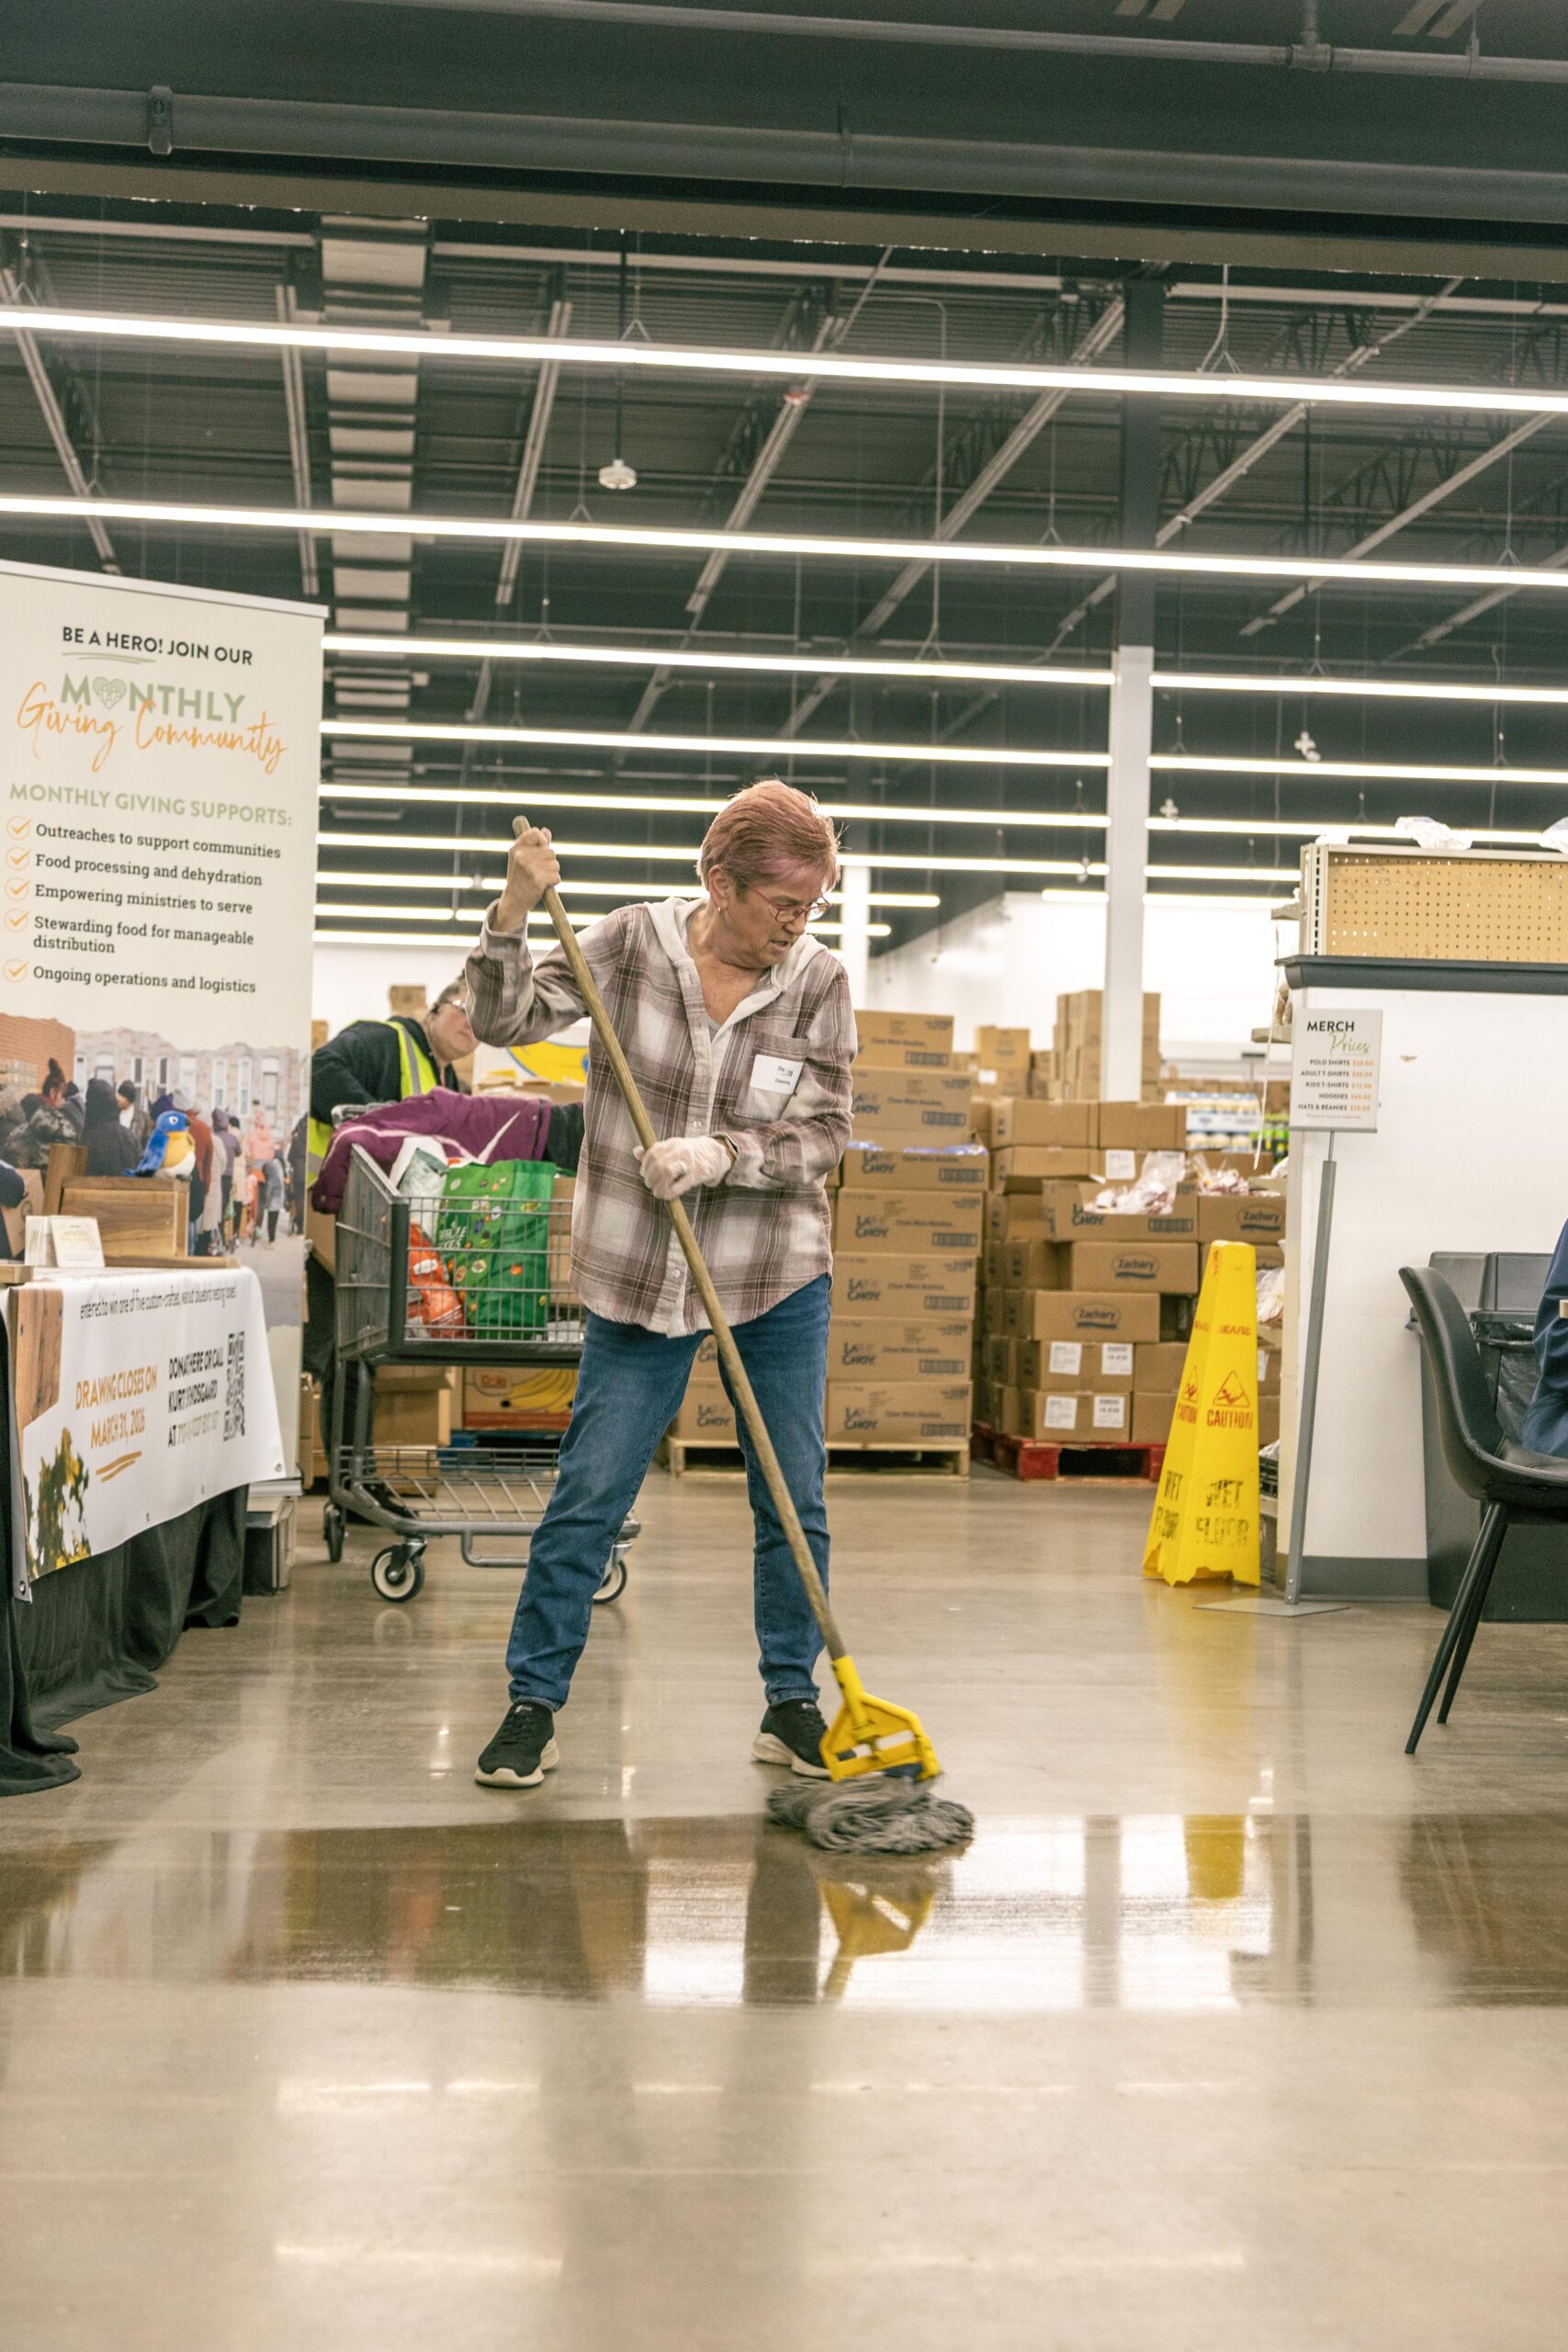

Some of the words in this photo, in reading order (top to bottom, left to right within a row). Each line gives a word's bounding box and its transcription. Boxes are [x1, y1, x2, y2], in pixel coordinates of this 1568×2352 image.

[62, 627, 85, 643] BE
[89, 631, 101, 645] A
[107, 632, 164, 653] HERO!
[167, 639, 209, 659] JOIN
[215, 648, 253, 665] OUR
[17, 682, 125, 773] Giving
[135, 698, 288, 775] Community
[9, 783, 110, 808] MONTHLY
[115, 793, 185, 815] GIVING
[190, 801, 292, 827] SUPPORTS:
[36, 824, 115, 844] Outreaches
[119, 832, 132, 845] to
[137, 833, 189, 852] support
[193, 840, 281, 859] communities
[35, 854, 71, 869] Food
[74, 859, 150, 878] processing
[153, 865, 177, 879] and
[181, 867, 263, 886] dehydration
[35, 885, 123, 906] Empowering
[127, 892, 196, 910] ministries
[200, 899, 213, 911] to
[217, 902, 253, 914] serve
[34, 916, 112, 937] Stewarding
[117, 922, 147, 937] food
[151, 925, 170, 938] for
[174, 930, 254, 945] manageable
[33, 935, 115, 954] distribution
[33, 966, 91, 985] Ongoing
[95, 971, 168, 987] operations
[172, 977, 196, 989] and
[199, 978, 256, 993] logistics
[1306, 1021, 1355, 1032] MERCH
[1329, 1030, 1371, 1056] Prices
[863, 1164, 896, 1174] CHOY
[856, 1216, 872, 1228] LA
[1072, 1214, 1105, 1227] CHOY
[1244, 1210, 1280, 1224] Zachary
[855, 1227, 889, 1238] CHOY
[1118, 1259, 1155, 1271] Zachary
[849, 1279, 863, 1290] LA
[848, 1291, 881, 1302] CHOY
[1078, 1309, 1116, 1321] Zachary
[843, 1342, 858, 1355] LA
[842, 1354, 875, 1365] CHOY
[117, 1367, 144, 1399] CLOSES
[145, 1364, 157, 1393] ON
[698, 1405, 712, 1416] LA
[845, 1408, 861, 1419] LA
[697, 1418, 731, 1427] CHOY
[844, 1419, 878, 1430] CHOY
[1207, 1409, 1253, 1430] CAUTION
[90, 1412, 118, 1449] MARCH
[167, 1425, 176, 1448] AT
[1163, 1469, 1183, 1503] WET
[1205, 1479, 1244, 1510] WET
